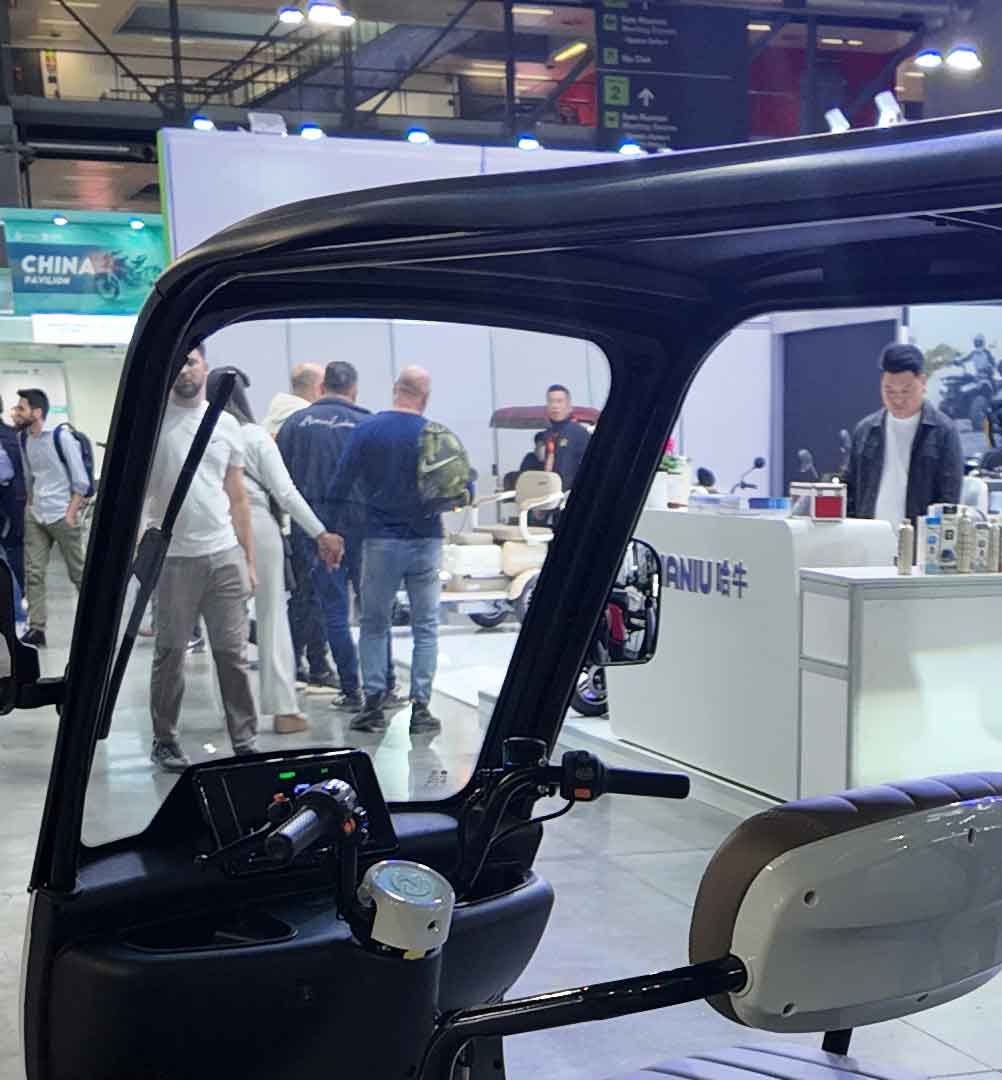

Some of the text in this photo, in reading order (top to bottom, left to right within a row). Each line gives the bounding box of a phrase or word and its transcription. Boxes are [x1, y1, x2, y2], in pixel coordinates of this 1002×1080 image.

[610, 85, 621, 100] 2
[21, 255, 95, 275] CHINA
[24, 276, 71, 286] PAVILION
